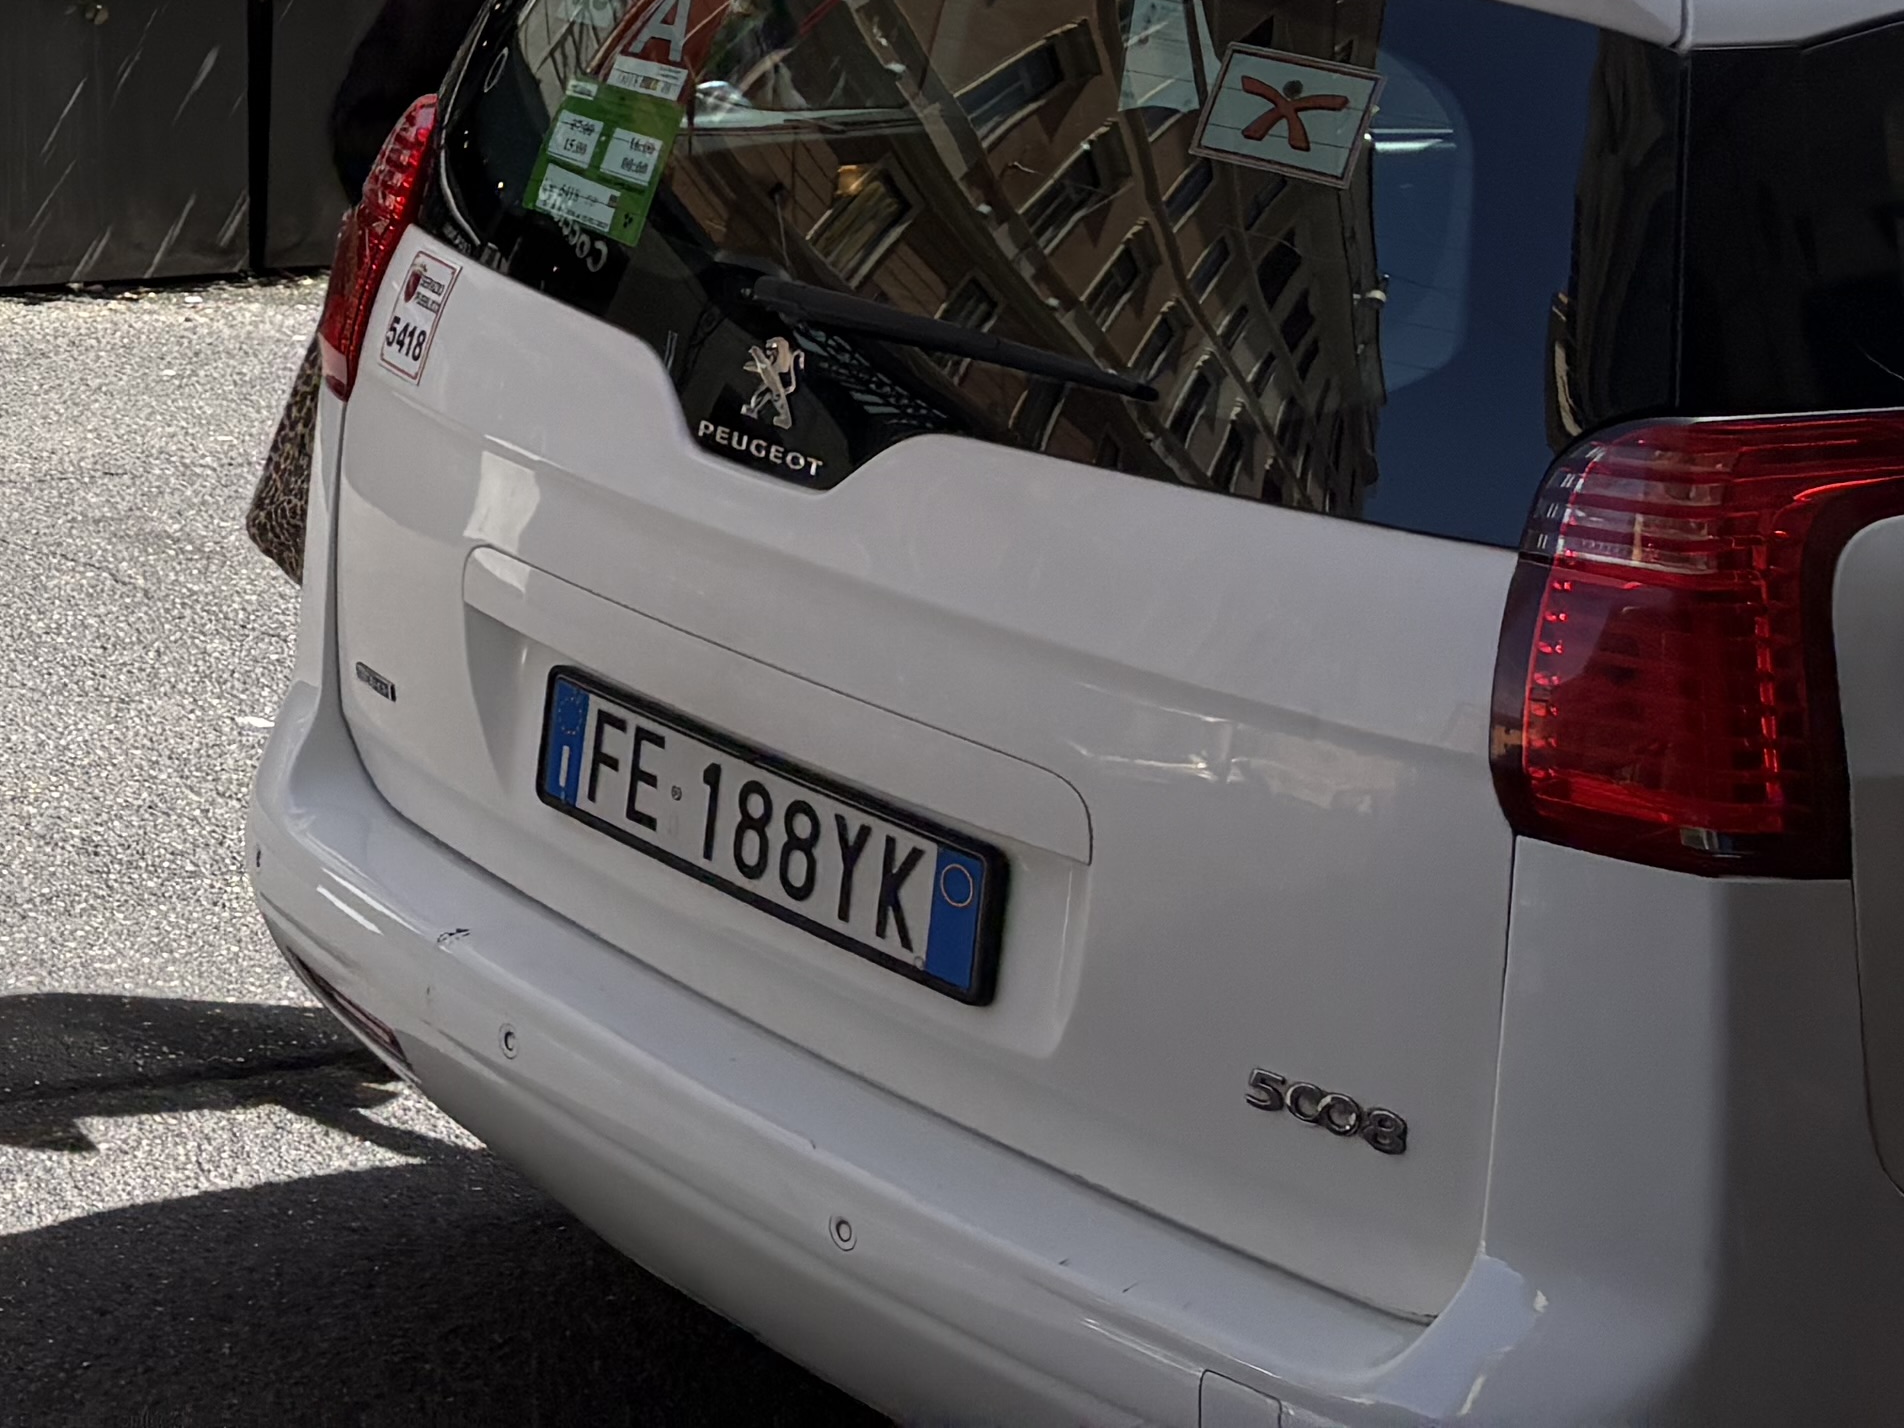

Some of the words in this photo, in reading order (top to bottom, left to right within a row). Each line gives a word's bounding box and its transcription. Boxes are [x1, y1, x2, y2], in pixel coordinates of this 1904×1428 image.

[385, 315, 427, 361] 5418
[698, 419, 824, 476] PEUGEOT
[1245, 1068, 1408, 1155] 5008
